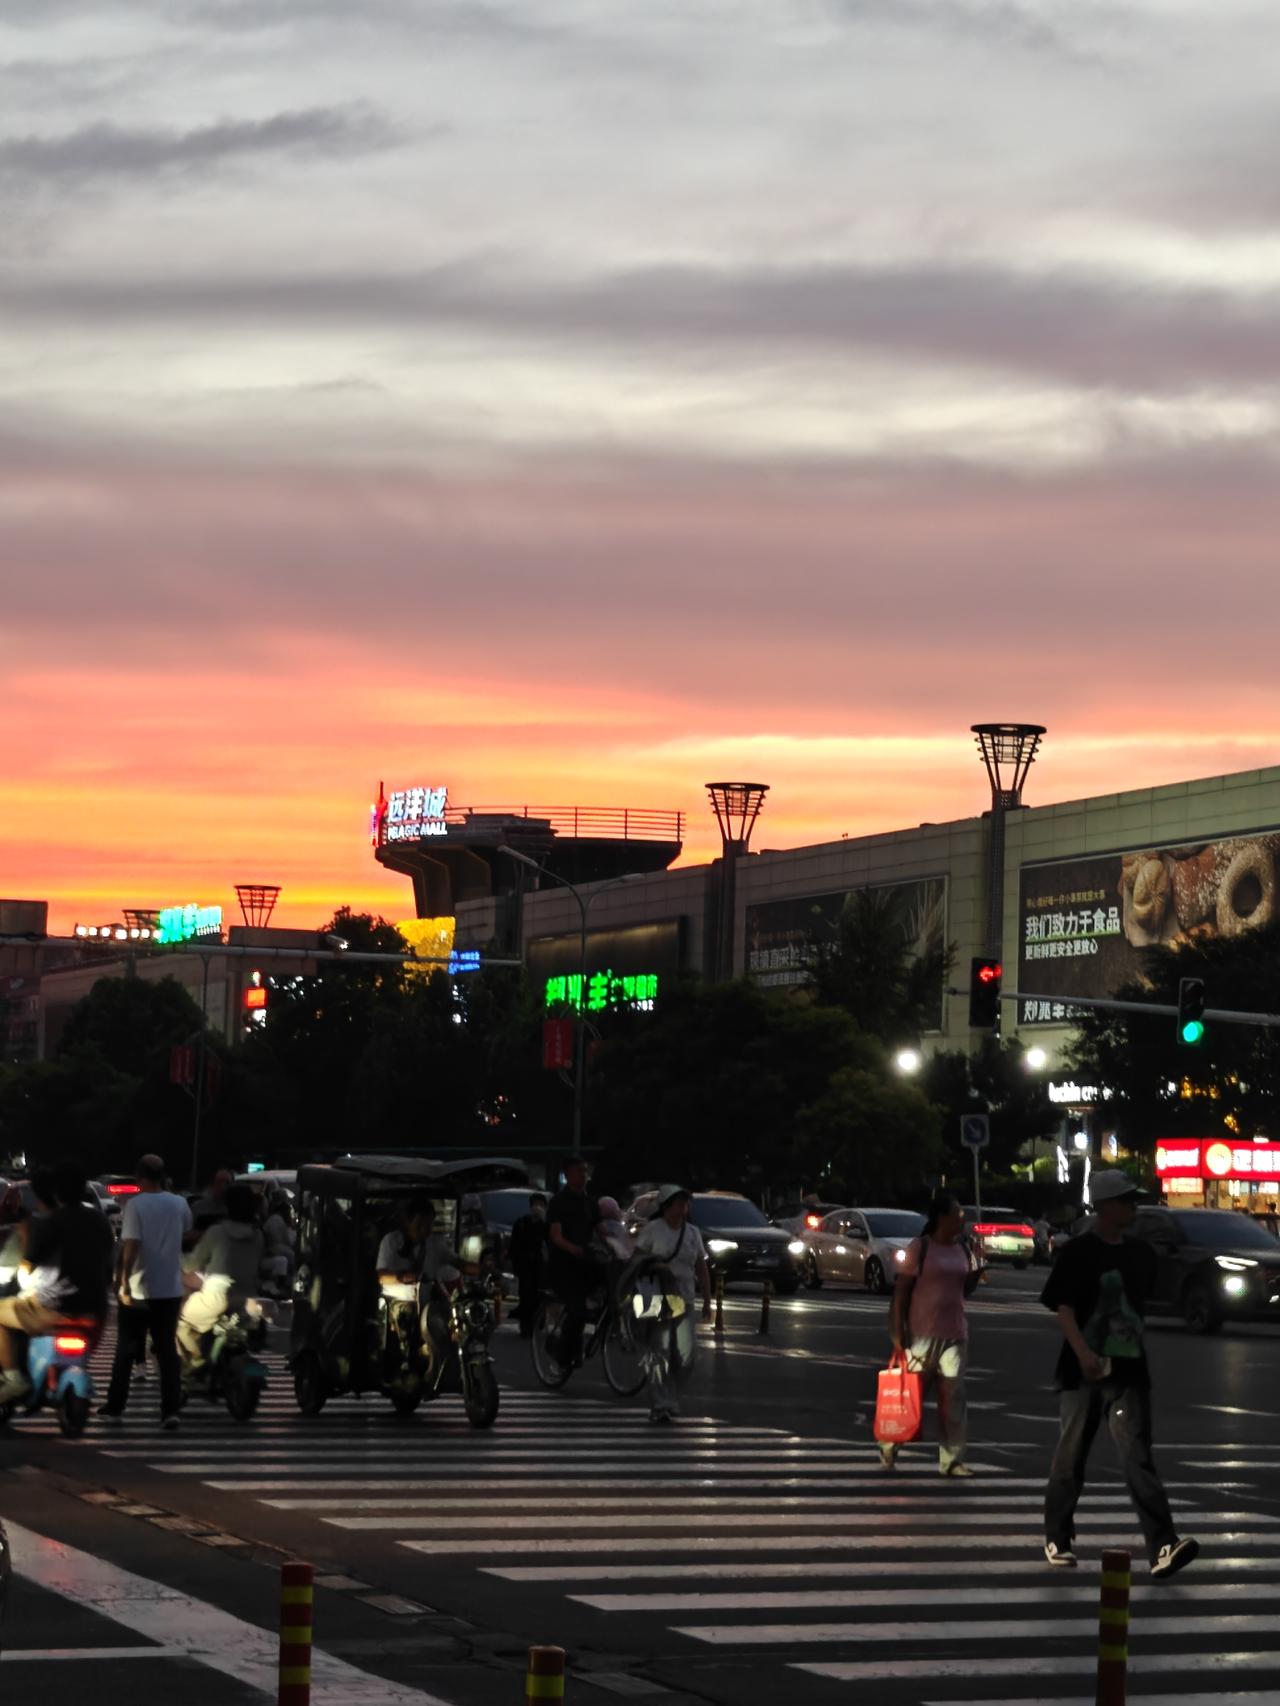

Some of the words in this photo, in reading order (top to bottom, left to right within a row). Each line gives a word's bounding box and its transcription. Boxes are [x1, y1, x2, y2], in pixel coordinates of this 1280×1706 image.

[387, 786, 447, 822] 远洋城
[420, 821, 448, 836] MALL
[1025, 906, 1120, 939] 我们致力于食品
[1025, 939, 1098, 960] 更新鲜更安全更放心
